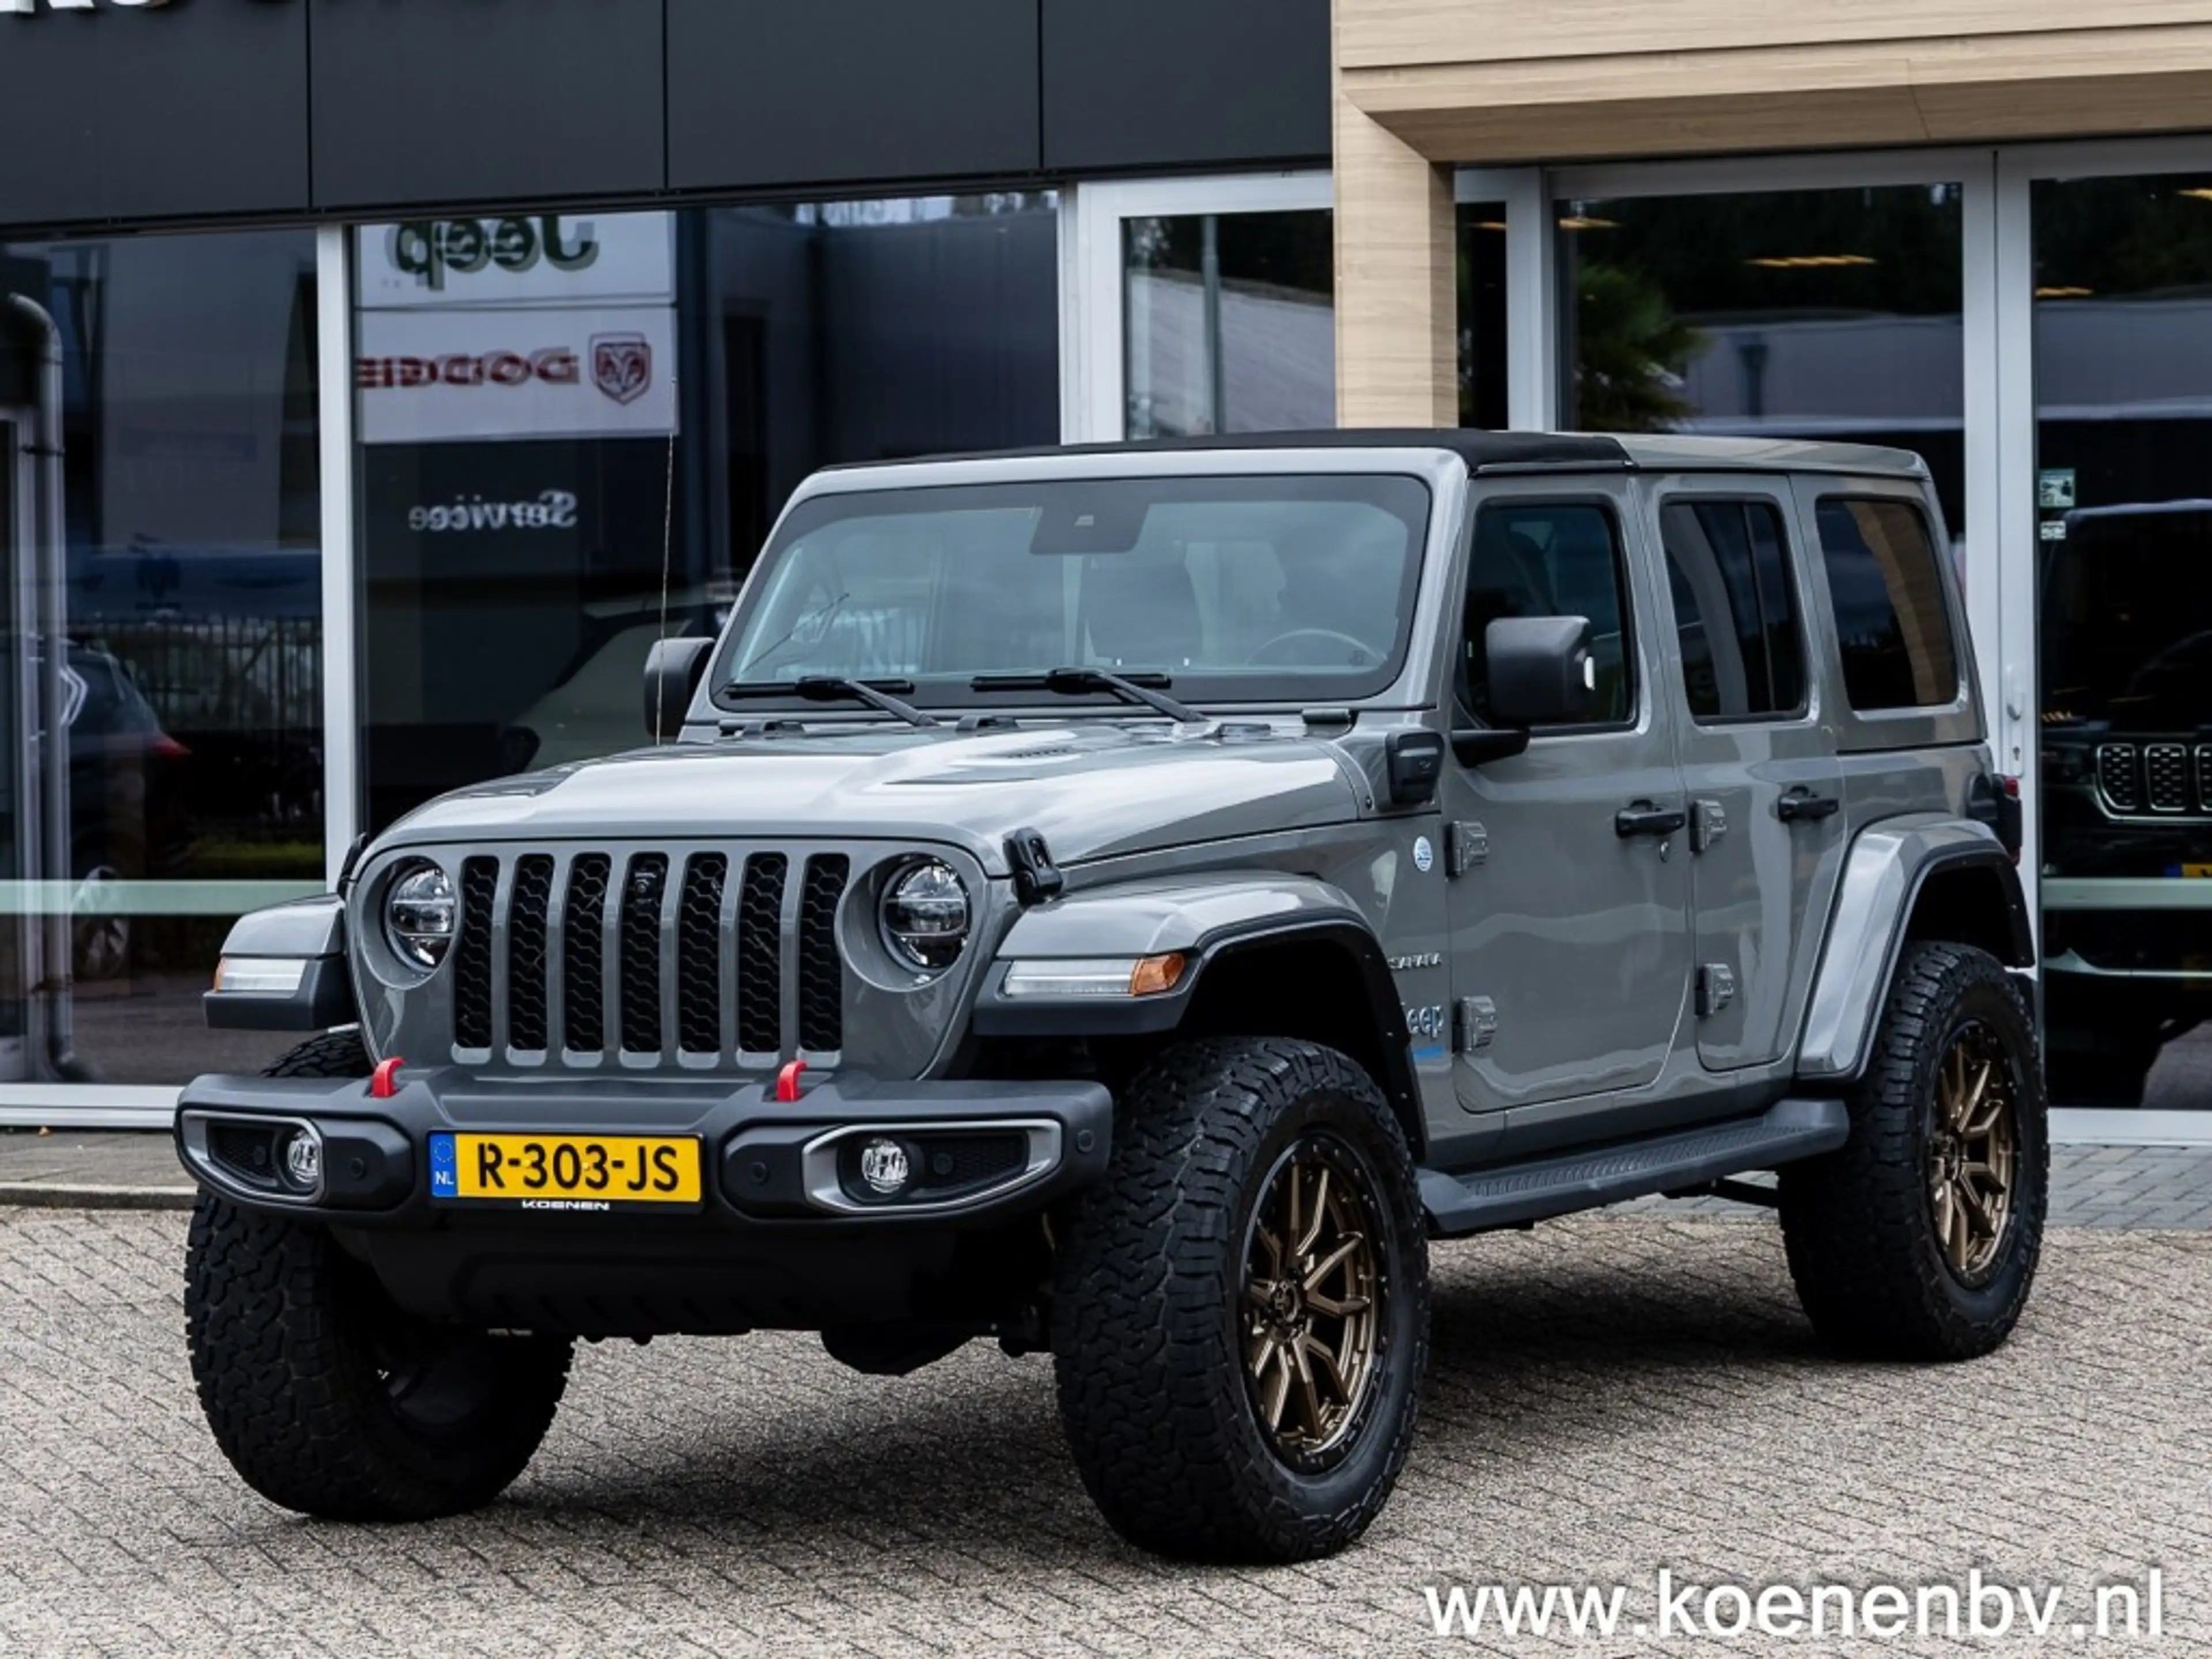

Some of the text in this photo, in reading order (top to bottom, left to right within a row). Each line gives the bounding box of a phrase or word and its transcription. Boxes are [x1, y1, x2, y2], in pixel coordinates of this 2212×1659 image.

[478, 1142, 679, 1192] R-303-JS
[435, 1170, 454, 1186] NL
[522, 1198, 610, 1211] KOENEN
